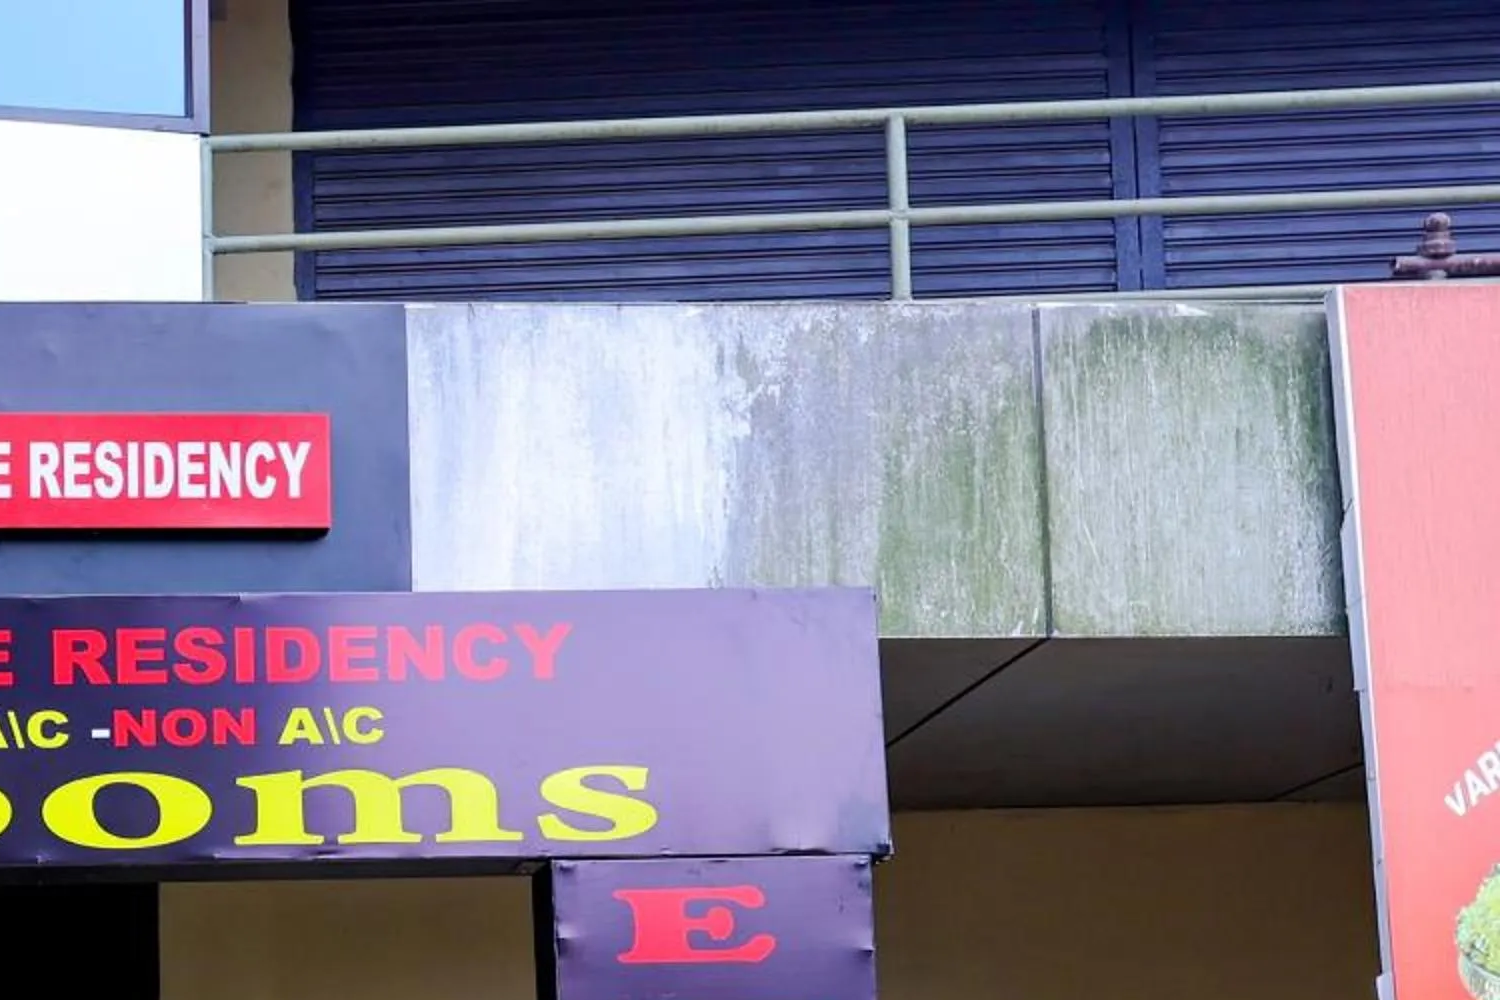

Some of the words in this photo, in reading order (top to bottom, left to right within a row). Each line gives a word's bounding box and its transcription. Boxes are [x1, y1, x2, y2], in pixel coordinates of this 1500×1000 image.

[29, 441, 311, 499] RESIDENCY
[52, 623, 572, 686] RESIDENCY
[279, 706, 384, 745] A\C
[1443, 739, 1500, 817] VAR
